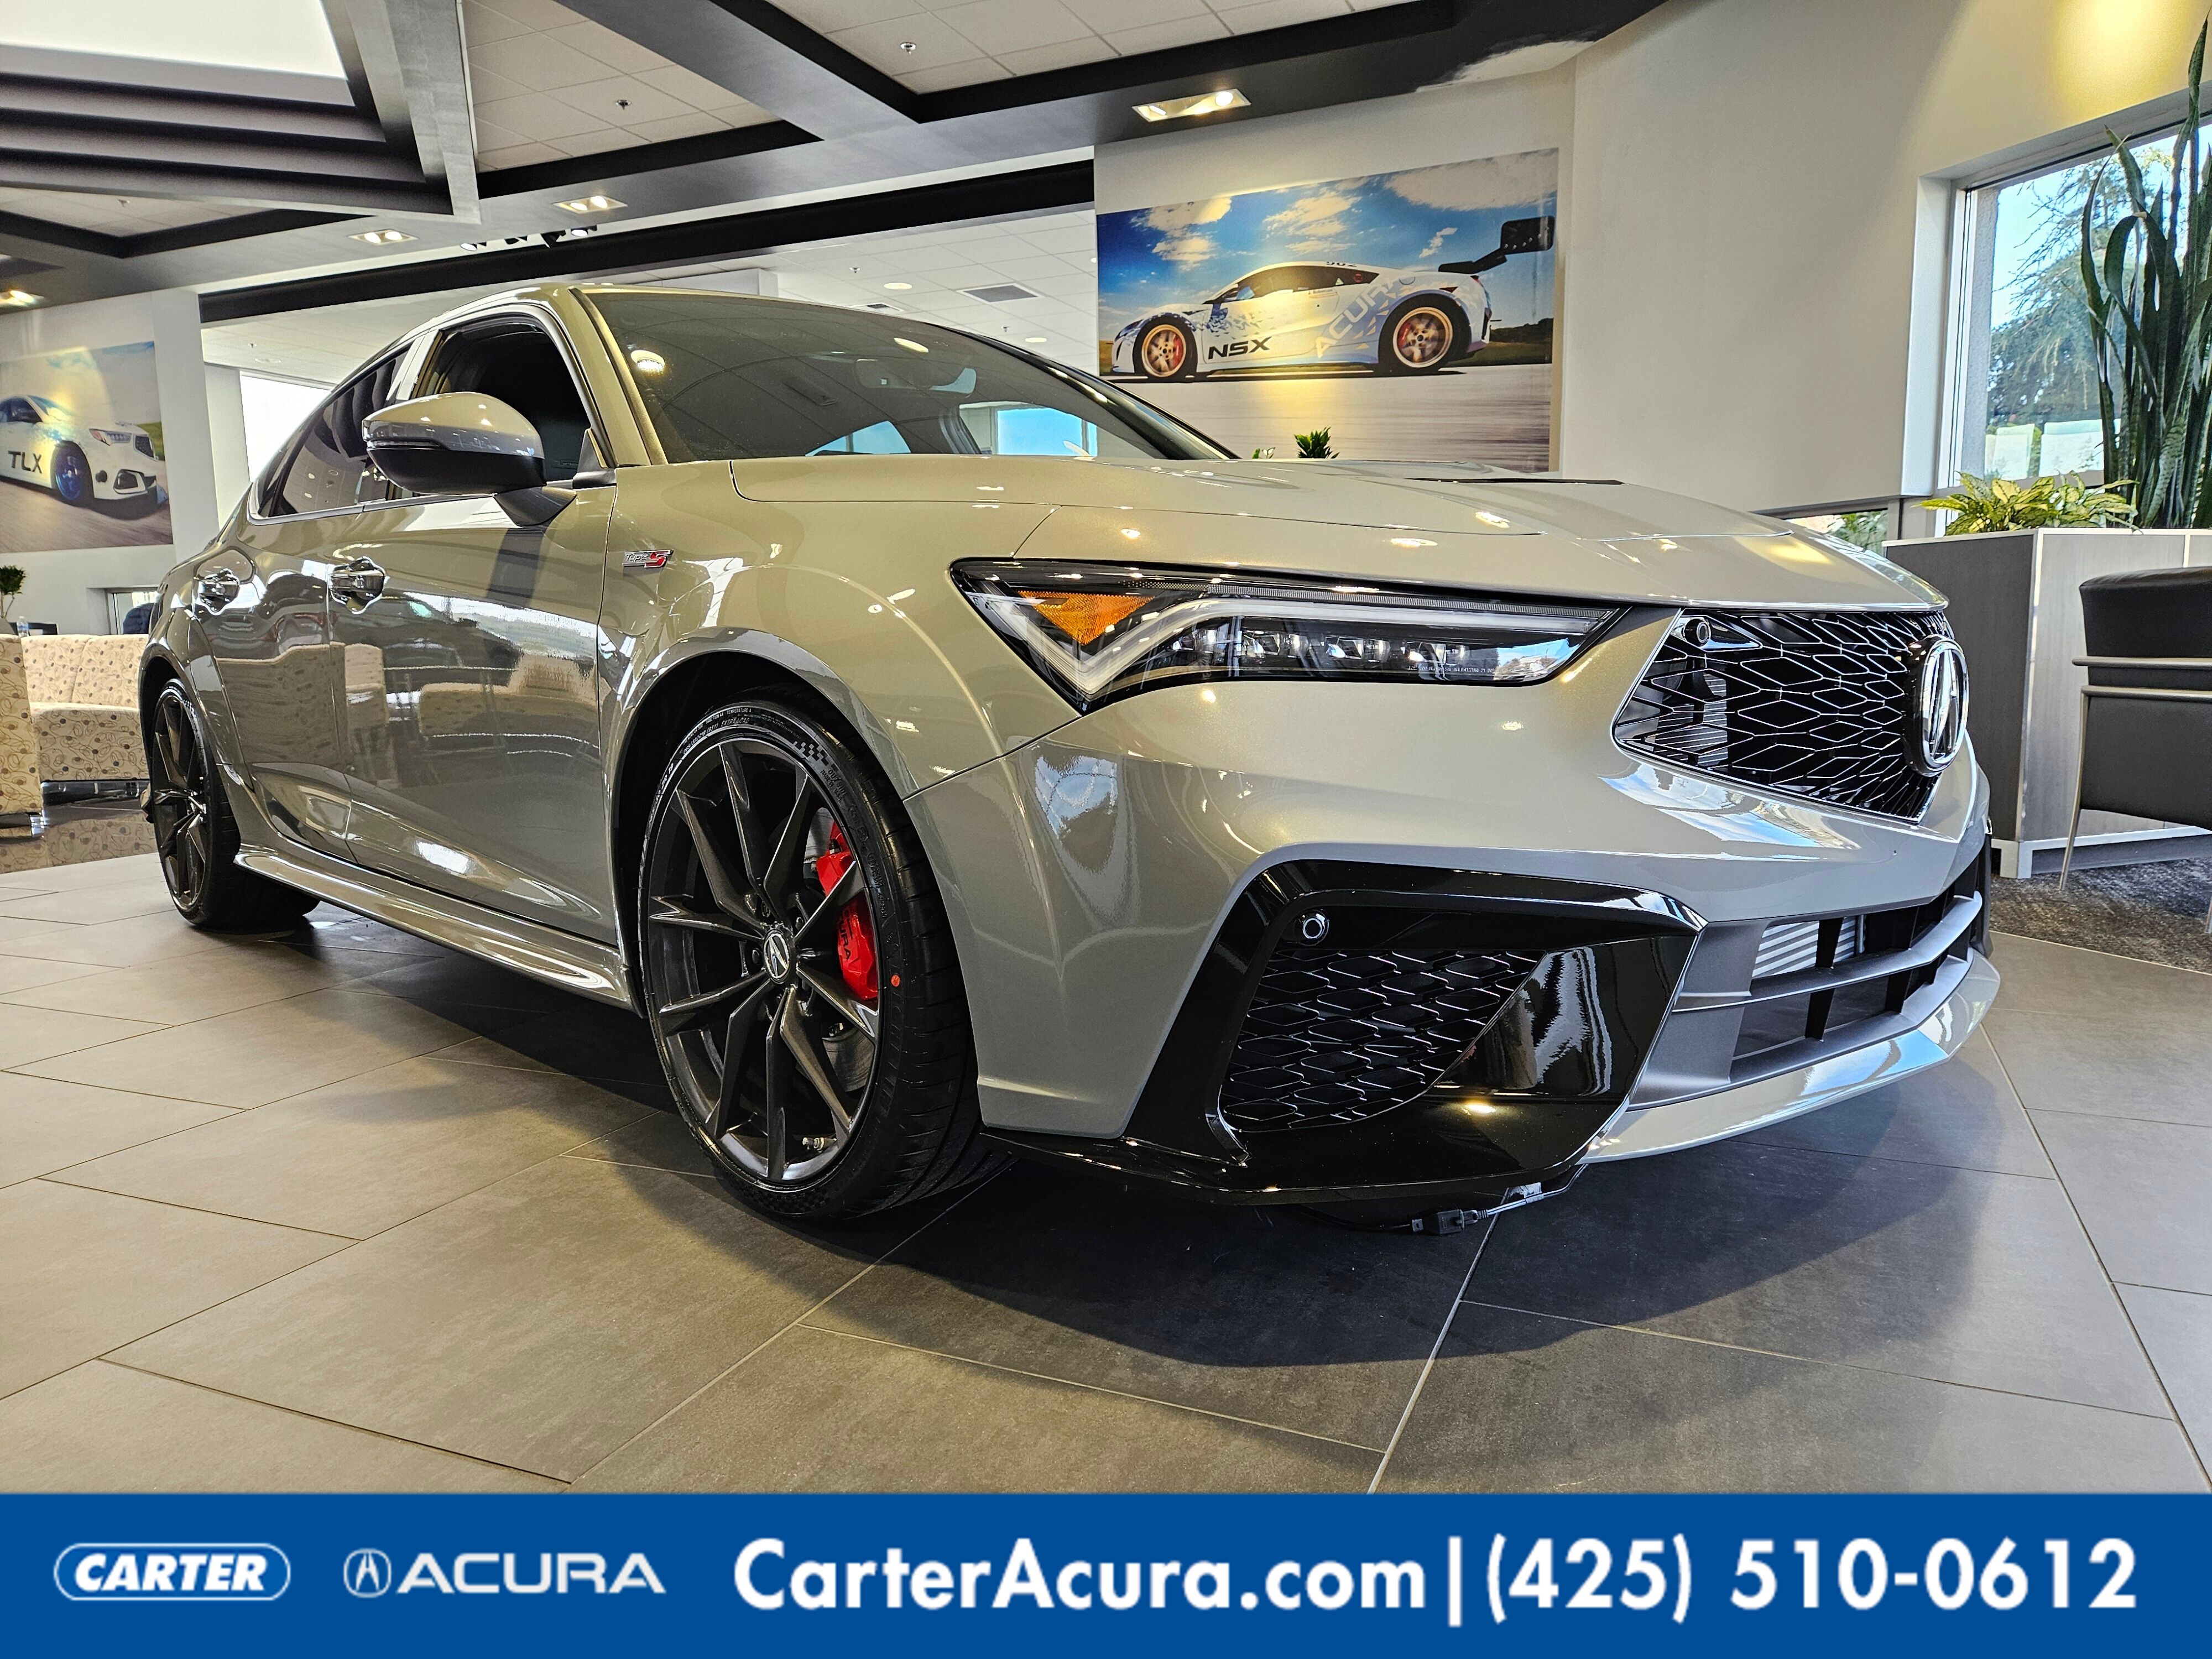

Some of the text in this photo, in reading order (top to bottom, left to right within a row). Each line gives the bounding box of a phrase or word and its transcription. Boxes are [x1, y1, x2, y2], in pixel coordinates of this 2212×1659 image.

[1316, 276, 1396, 359] ACUR
[1208, 336, 1272, 359] NSX
[8, 450, 42, 473] TLX
[625, 550, 671, 568] Type S
[838, 911, 852, 961] URA
